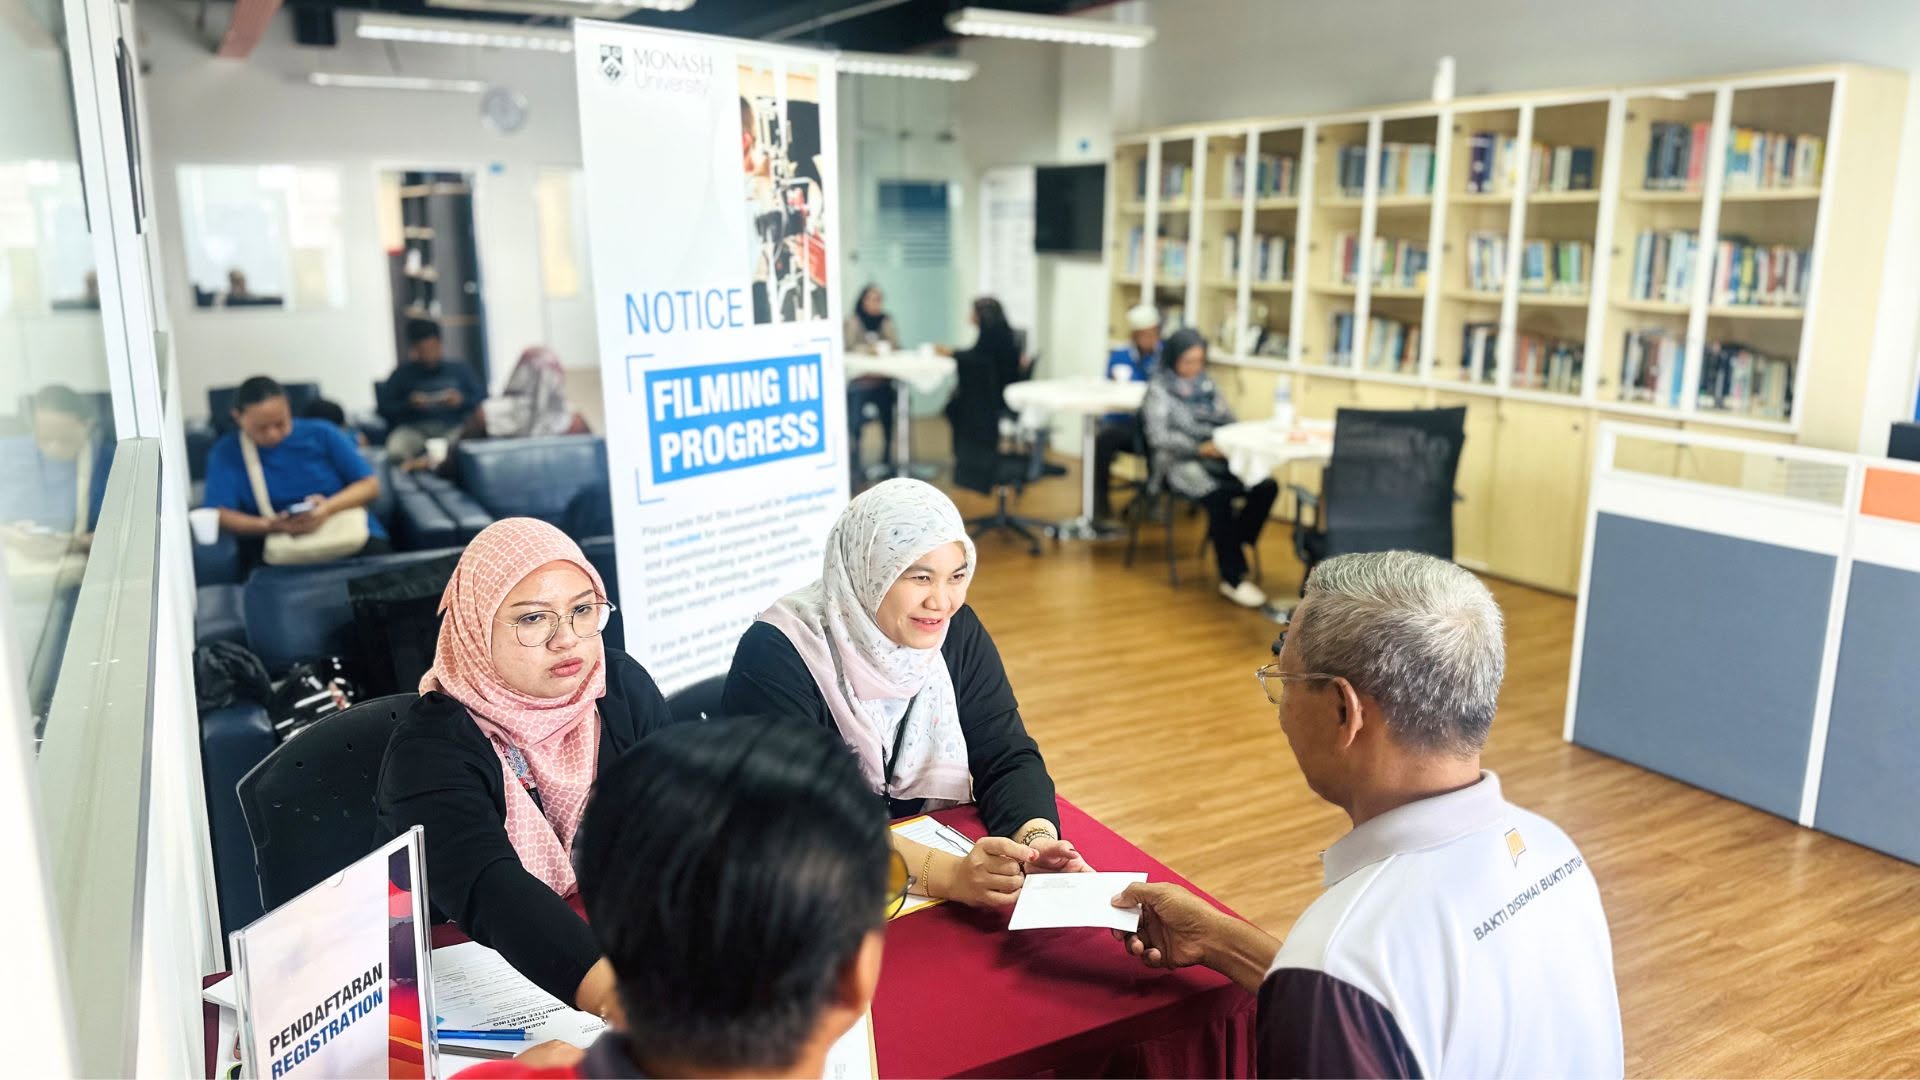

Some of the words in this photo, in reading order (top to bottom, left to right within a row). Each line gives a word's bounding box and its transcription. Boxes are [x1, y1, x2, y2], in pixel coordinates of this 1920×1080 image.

[633, 48, 713, 75] MONASH
[635, 67, 711, 97] University
[625, 288, 744, 335] NOTICE
[652, 367, 781, 421] FILMING
[788, 363, 820, 402] IN
[659, 410, 820, 473] PROGRESS
[1473, 909, 1509, 941] BAKTI
[1506, 883, 1541, 916] DISEMAI
[1539, 866, 1567, 891] BUKTI
[269, 962, 382, 1057] PENDAFTARAN
[271, 986, 383, 1080] REGISTRATION
[508, 1015, 549, 1027] TECHNICAL
